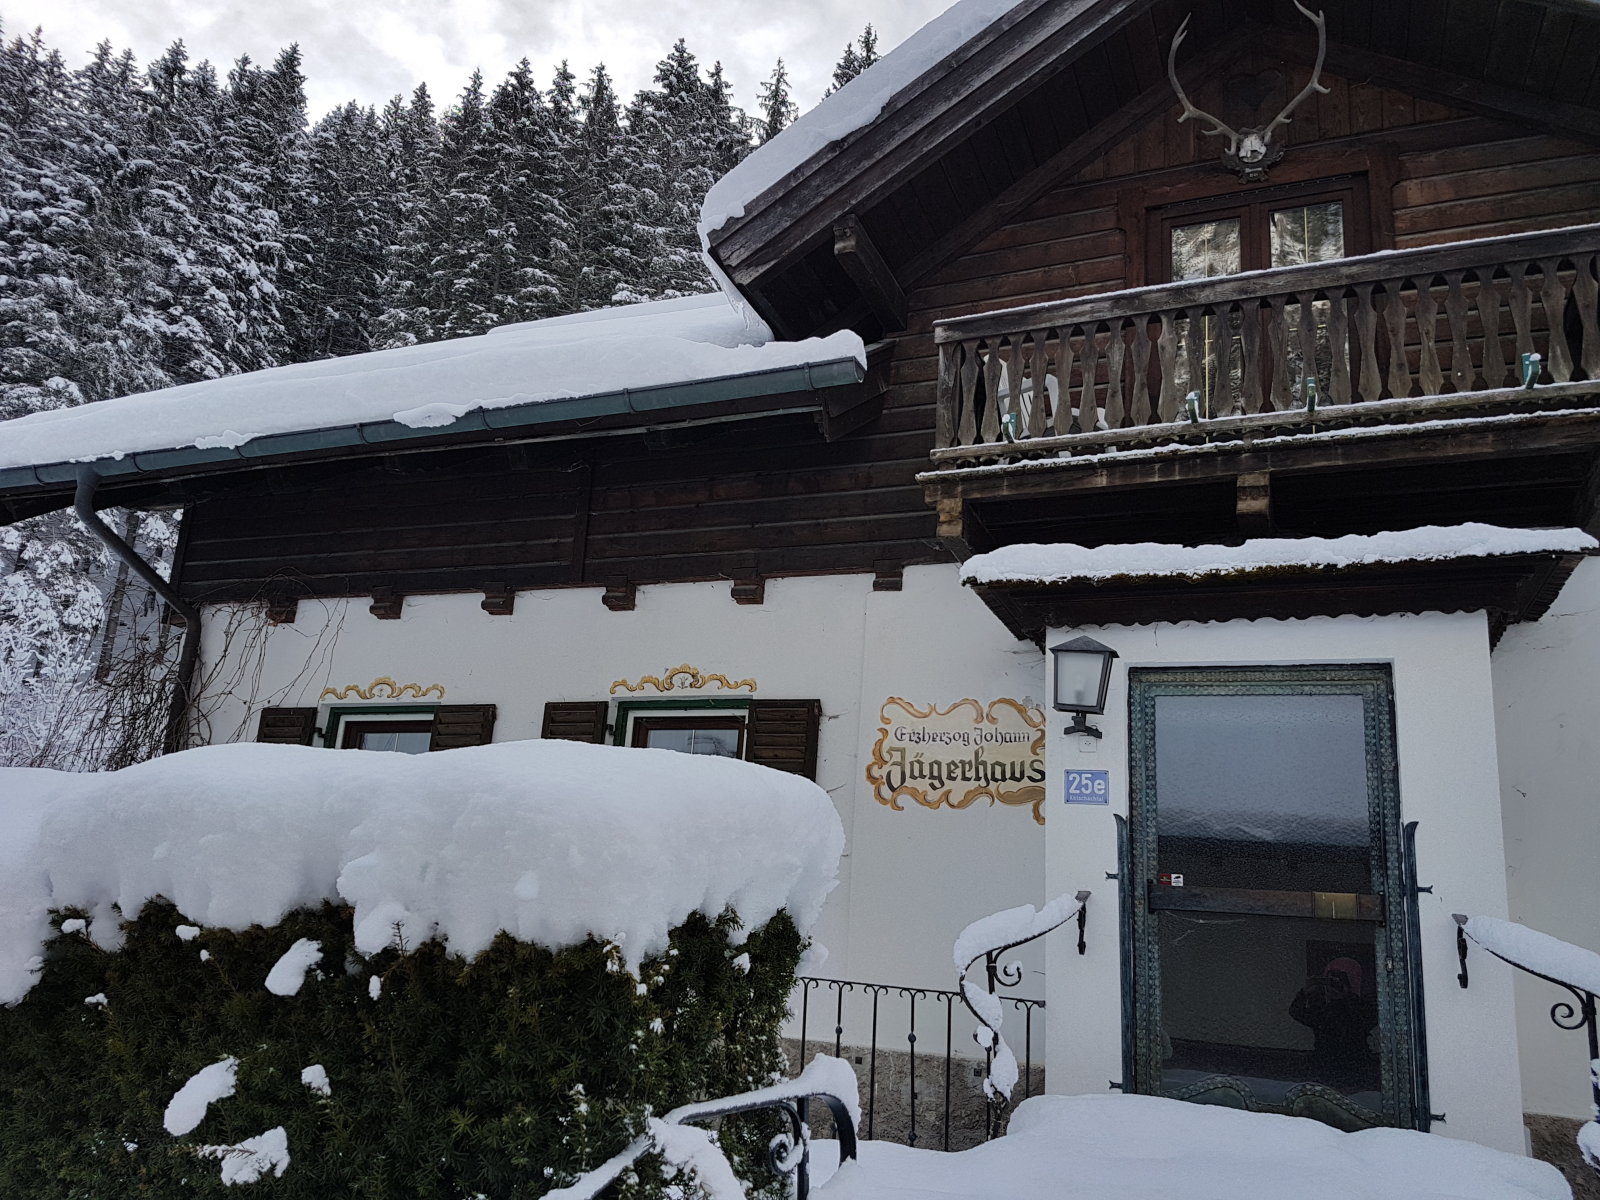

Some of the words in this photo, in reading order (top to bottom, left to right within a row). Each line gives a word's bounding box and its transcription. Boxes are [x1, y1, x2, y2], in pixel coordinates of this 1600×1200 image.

[894, 726, 970, 746] Erzherzog
[973, 726, 1031, 746] Johann
[885, 745, 1046, 792] Jägerhaus
[1068, 772, 1106, 795] 25e
